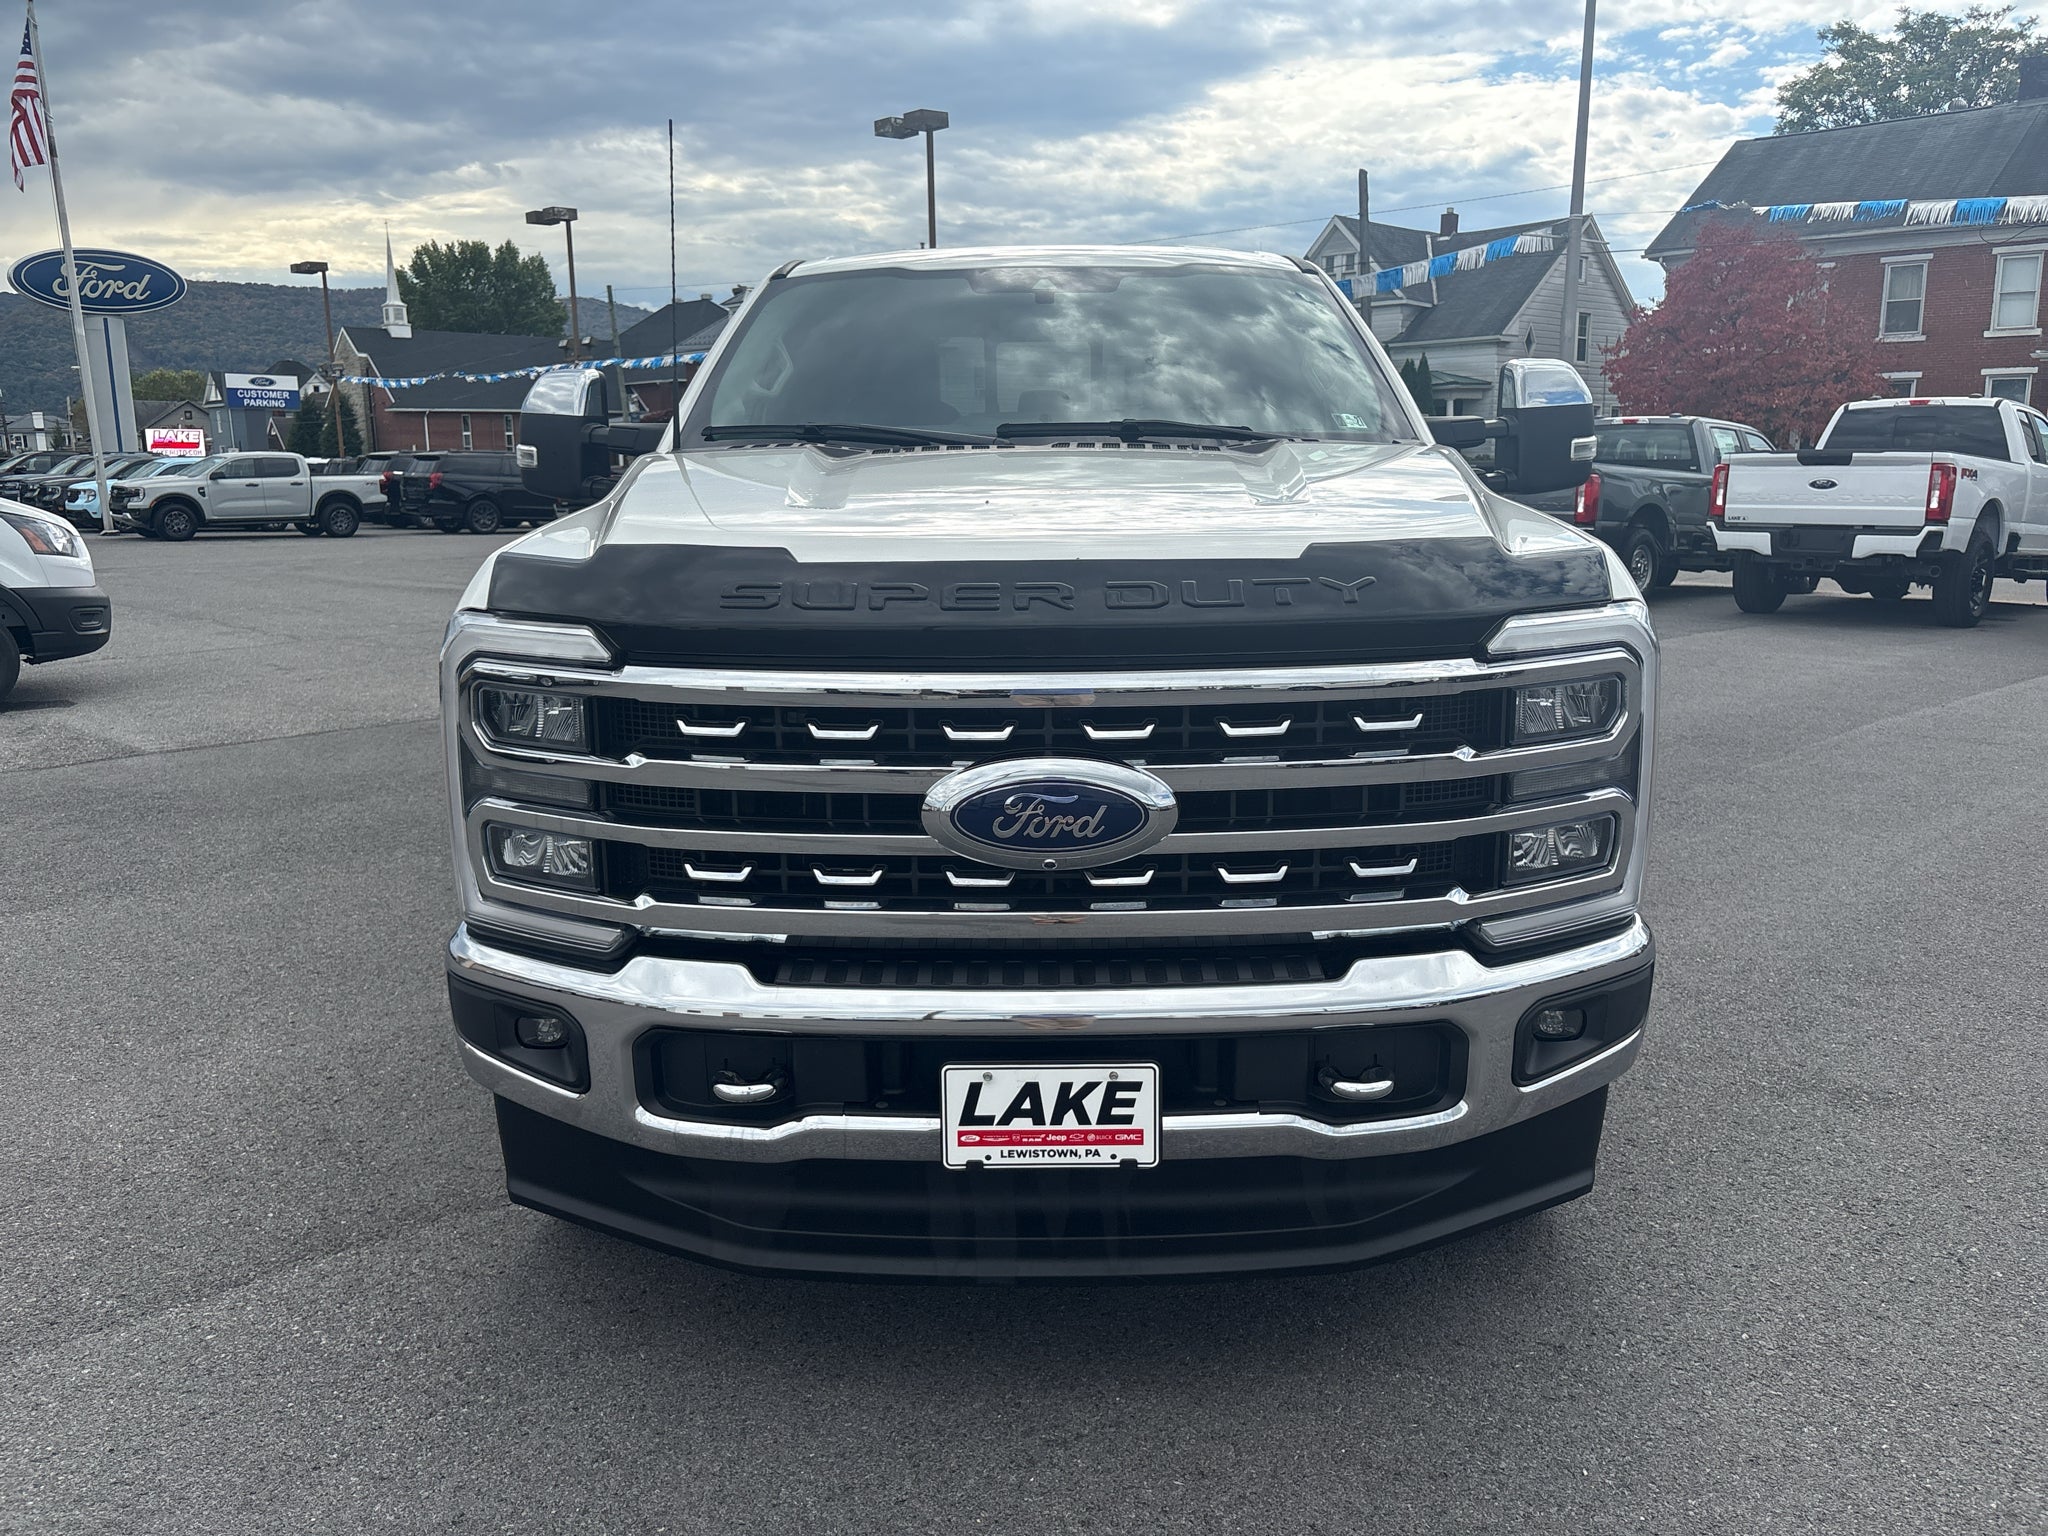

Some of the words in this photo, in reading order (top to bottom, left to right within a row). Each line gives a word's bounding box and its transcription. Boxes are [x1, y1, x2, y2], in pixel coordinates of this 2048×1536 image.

[52, 260, 151, 300] Ford
[237, 389, 290, 399] CUSTOMER
[243, 398, 286, 408] PARKING
[153, 430, 200, 443] LAKE
[720, 582, 1075, 611] SUPER
[1104, 576, 1378, 609] DUTY
[992, 793, 1108, 838] Ford
[958, 1081, 1143, 1126] LAKE
[1046, 1134, 1067, 1142] Jeep
[1000, 1149, 1081, 1159] LEWISTOWN,
[1085, 1149, 1101, 1158] PA
